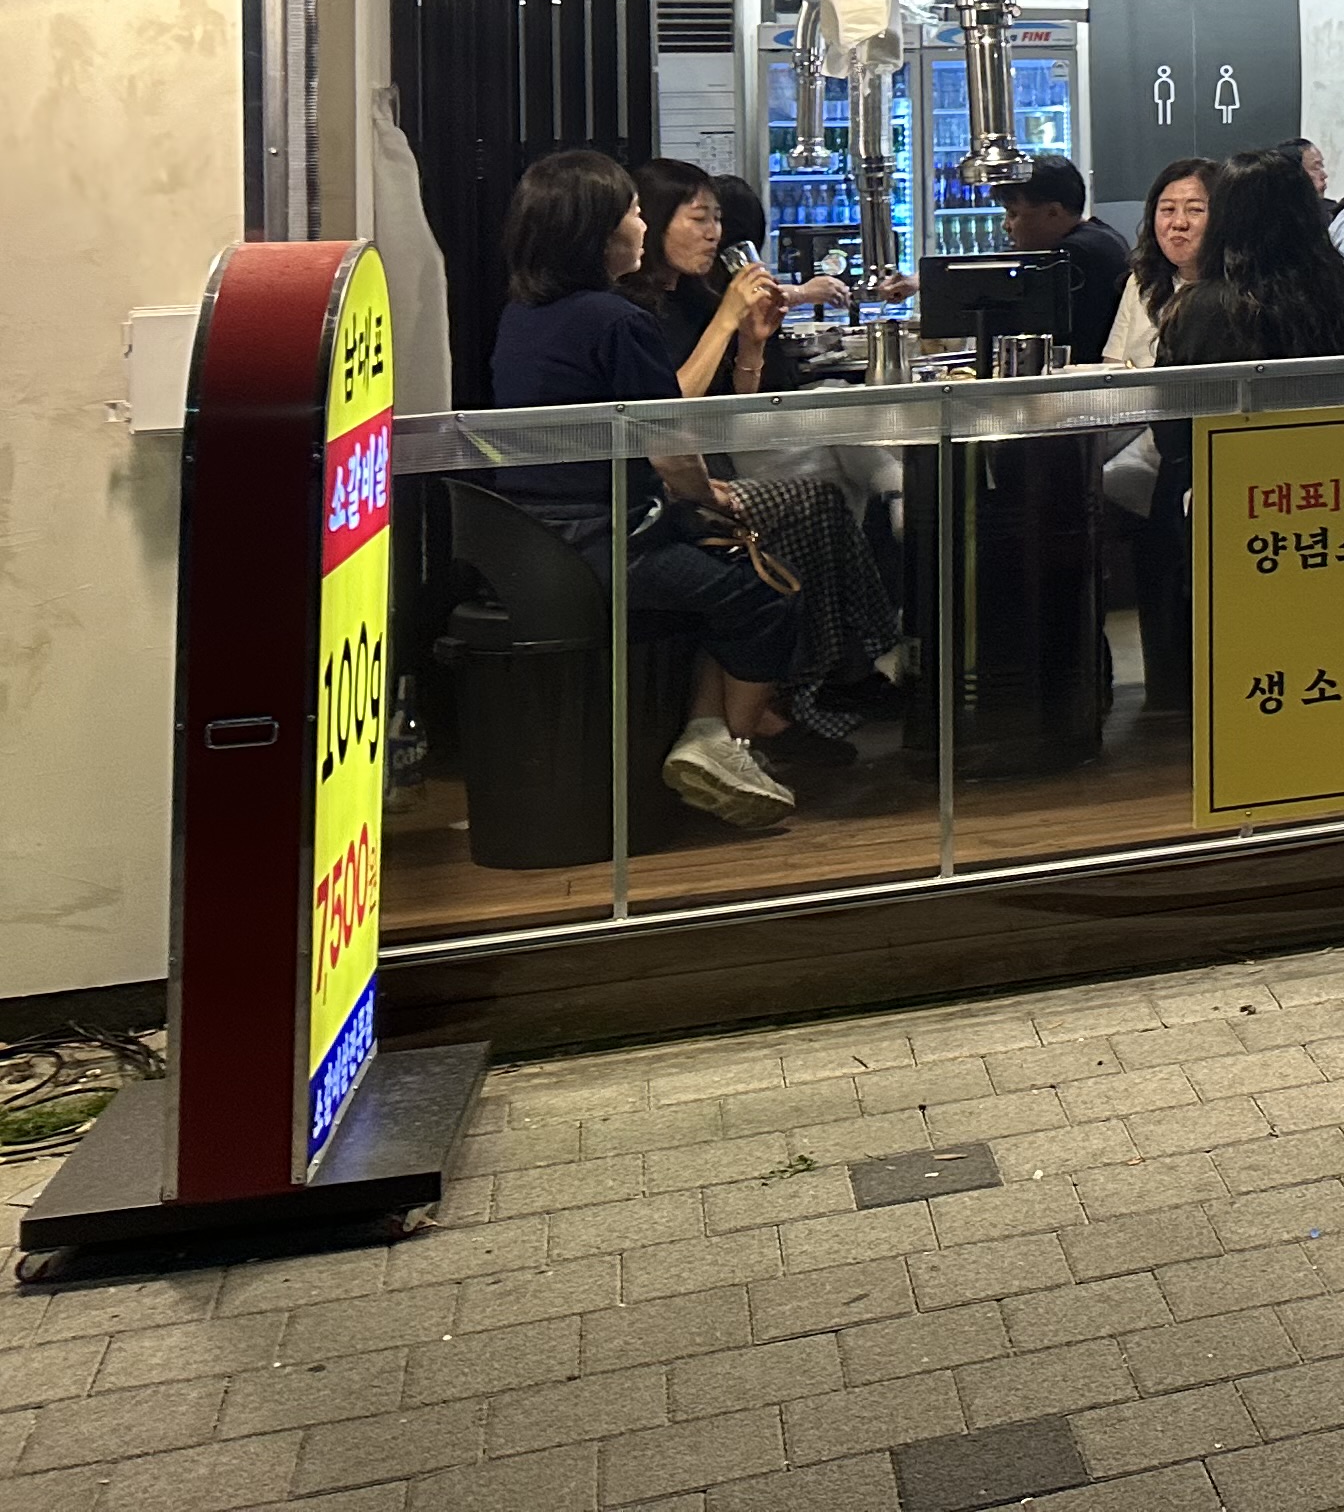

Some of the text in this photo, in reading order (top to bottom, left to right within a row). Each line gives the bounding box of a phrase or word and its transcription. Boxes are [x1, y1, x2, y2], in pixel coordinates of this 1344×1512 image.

[1021, 31, 1053, 43] FINE
[328, 425, 389, 532] 소갈비살
[321, 621, 383, 785] 100g
